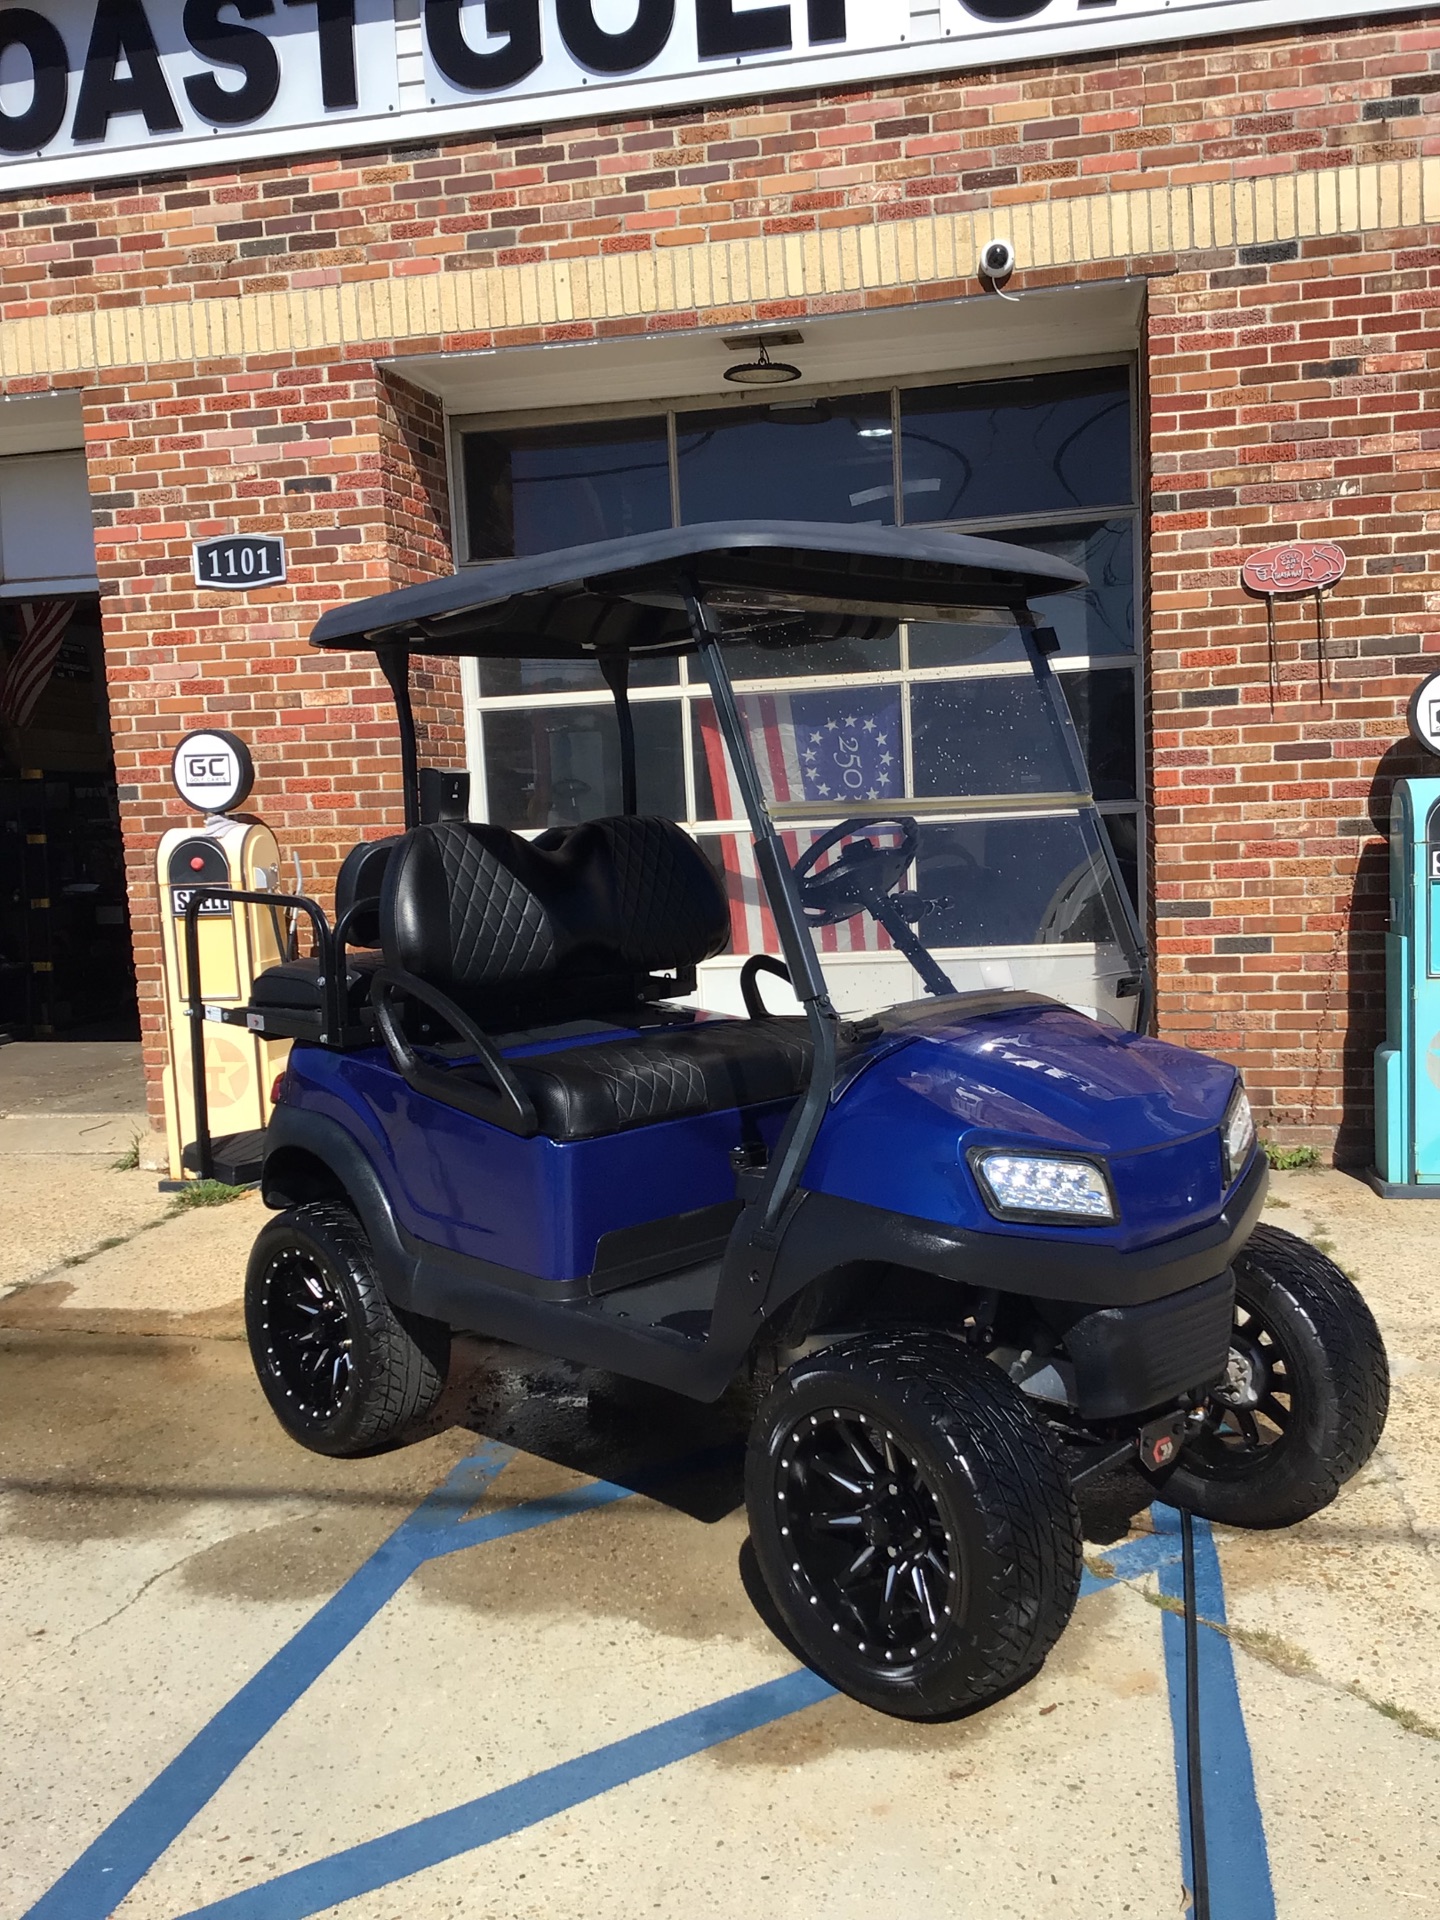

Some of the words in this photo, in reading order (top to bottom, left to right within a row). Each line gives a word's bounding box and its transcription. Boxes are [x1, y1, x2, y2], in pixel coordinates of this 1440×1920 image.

[208, 546, 270, 577] 1101
[189, 758, 225, 776] GC
[833, 736, 862, 788] 250
[177, 890, 228, 910] SLL
